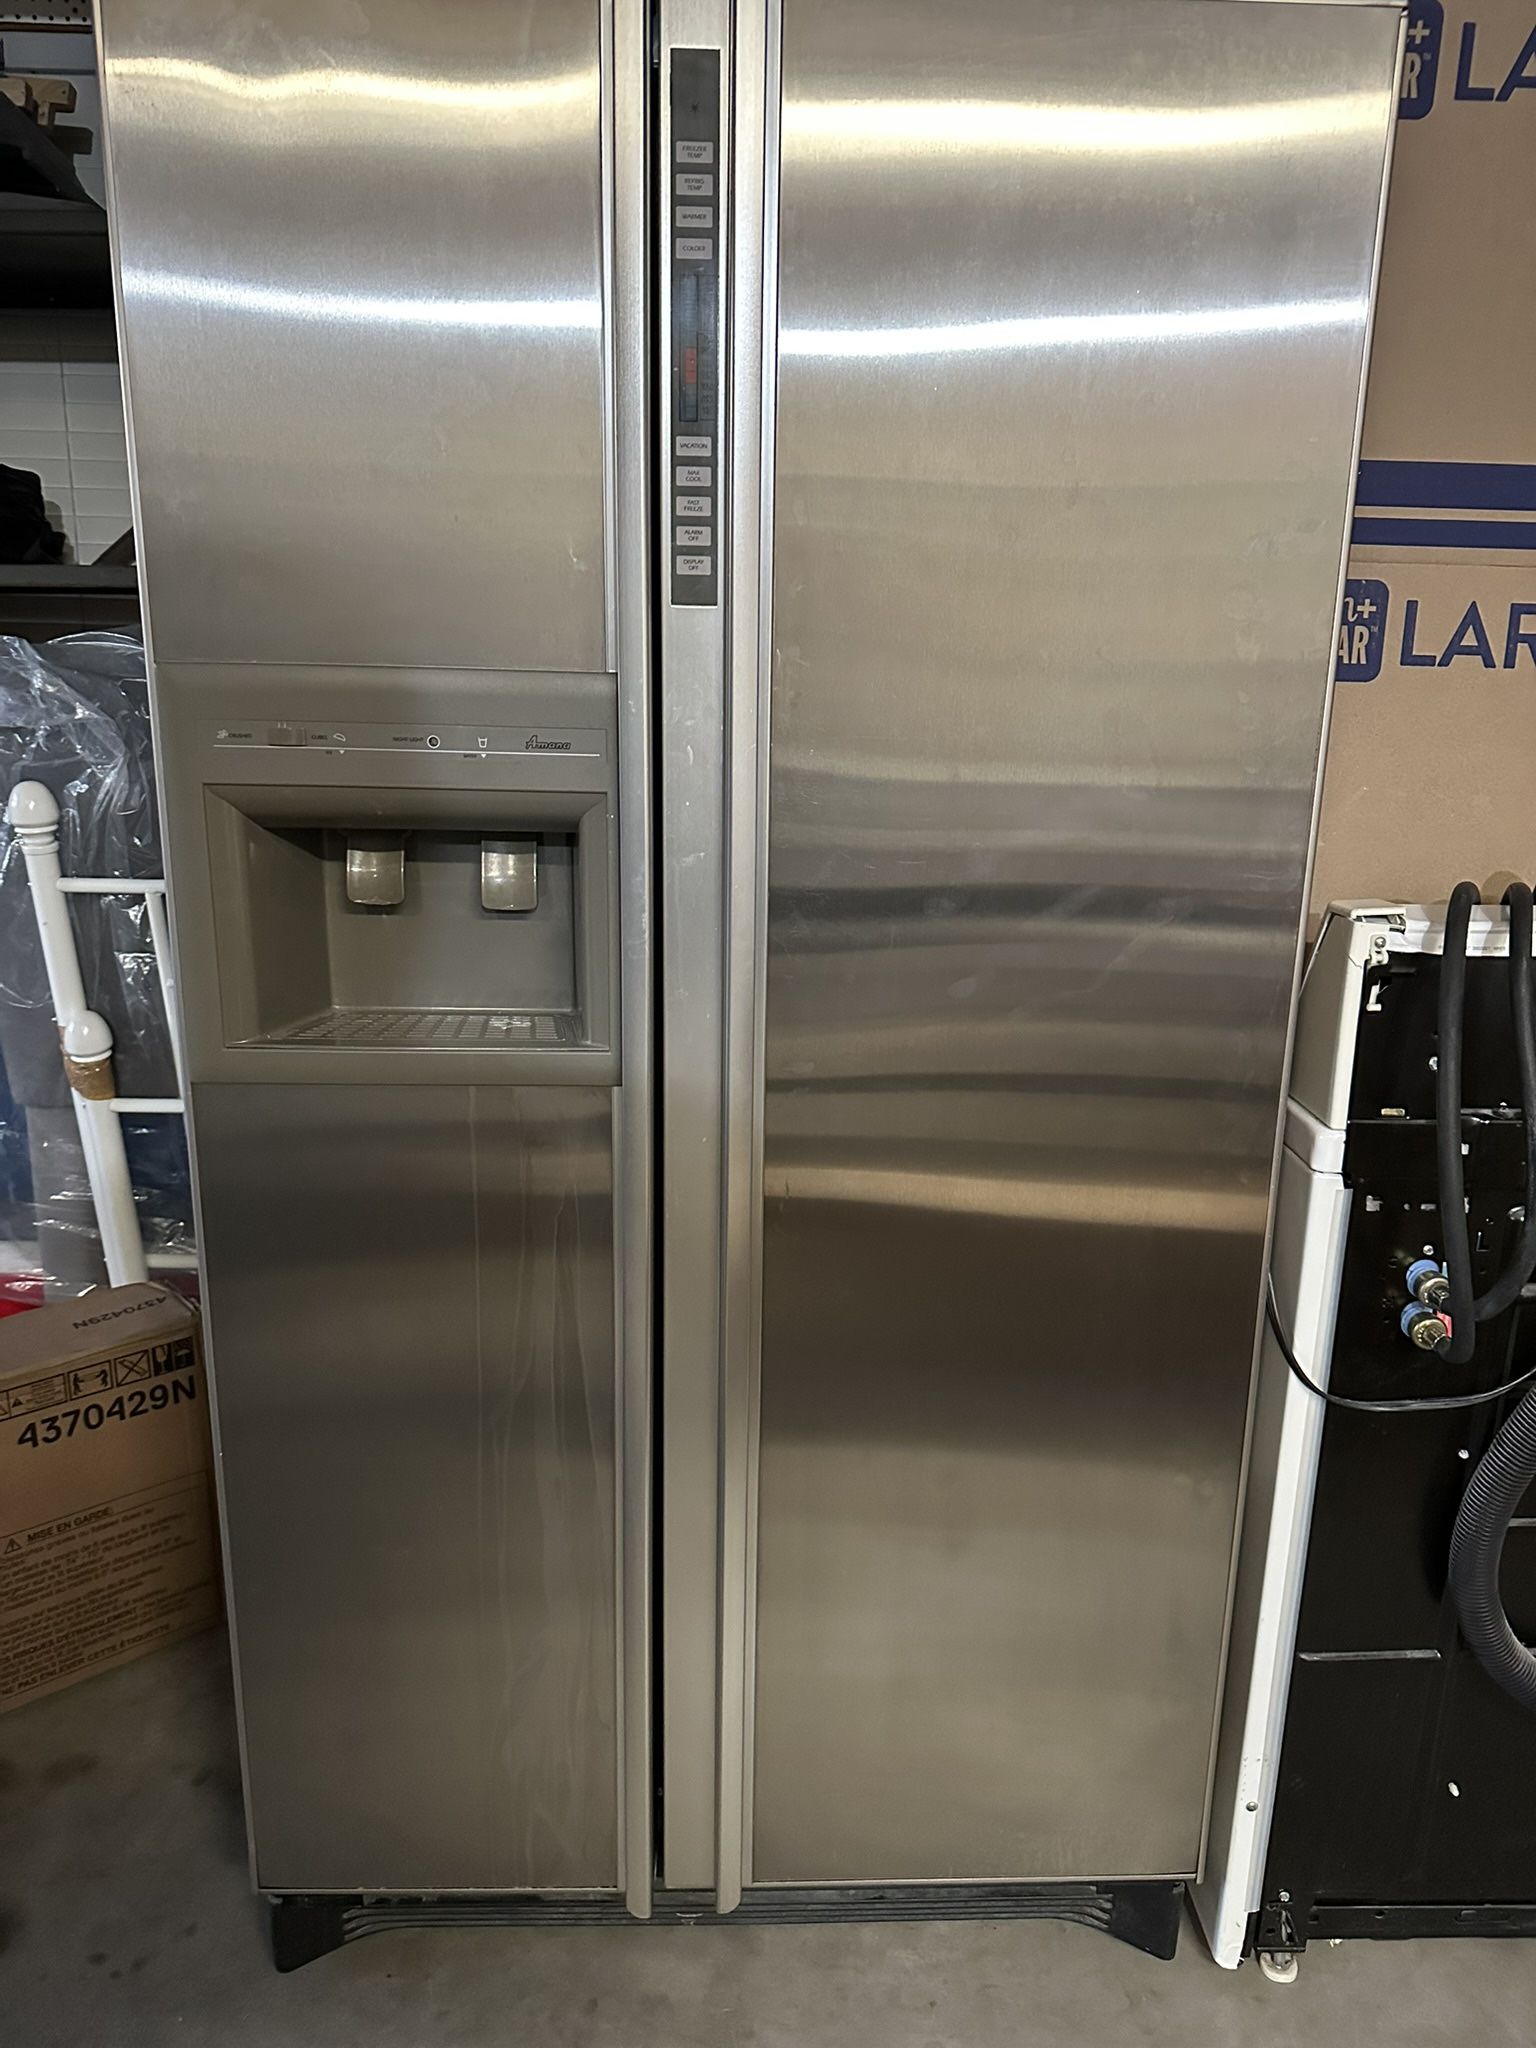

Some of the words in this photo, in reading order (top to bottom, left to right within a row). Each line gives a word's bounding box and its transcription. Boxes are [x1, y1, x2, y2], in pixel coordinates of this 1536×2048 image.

[525, 734, 571, 750] Amana
[72, 1296, 167, 1329] 4370429N
[17, 1376, 196, 1448] 4370429N
[26, 1526, 55, 1542] MISE
[56, 1520, 72, 1532] EN
